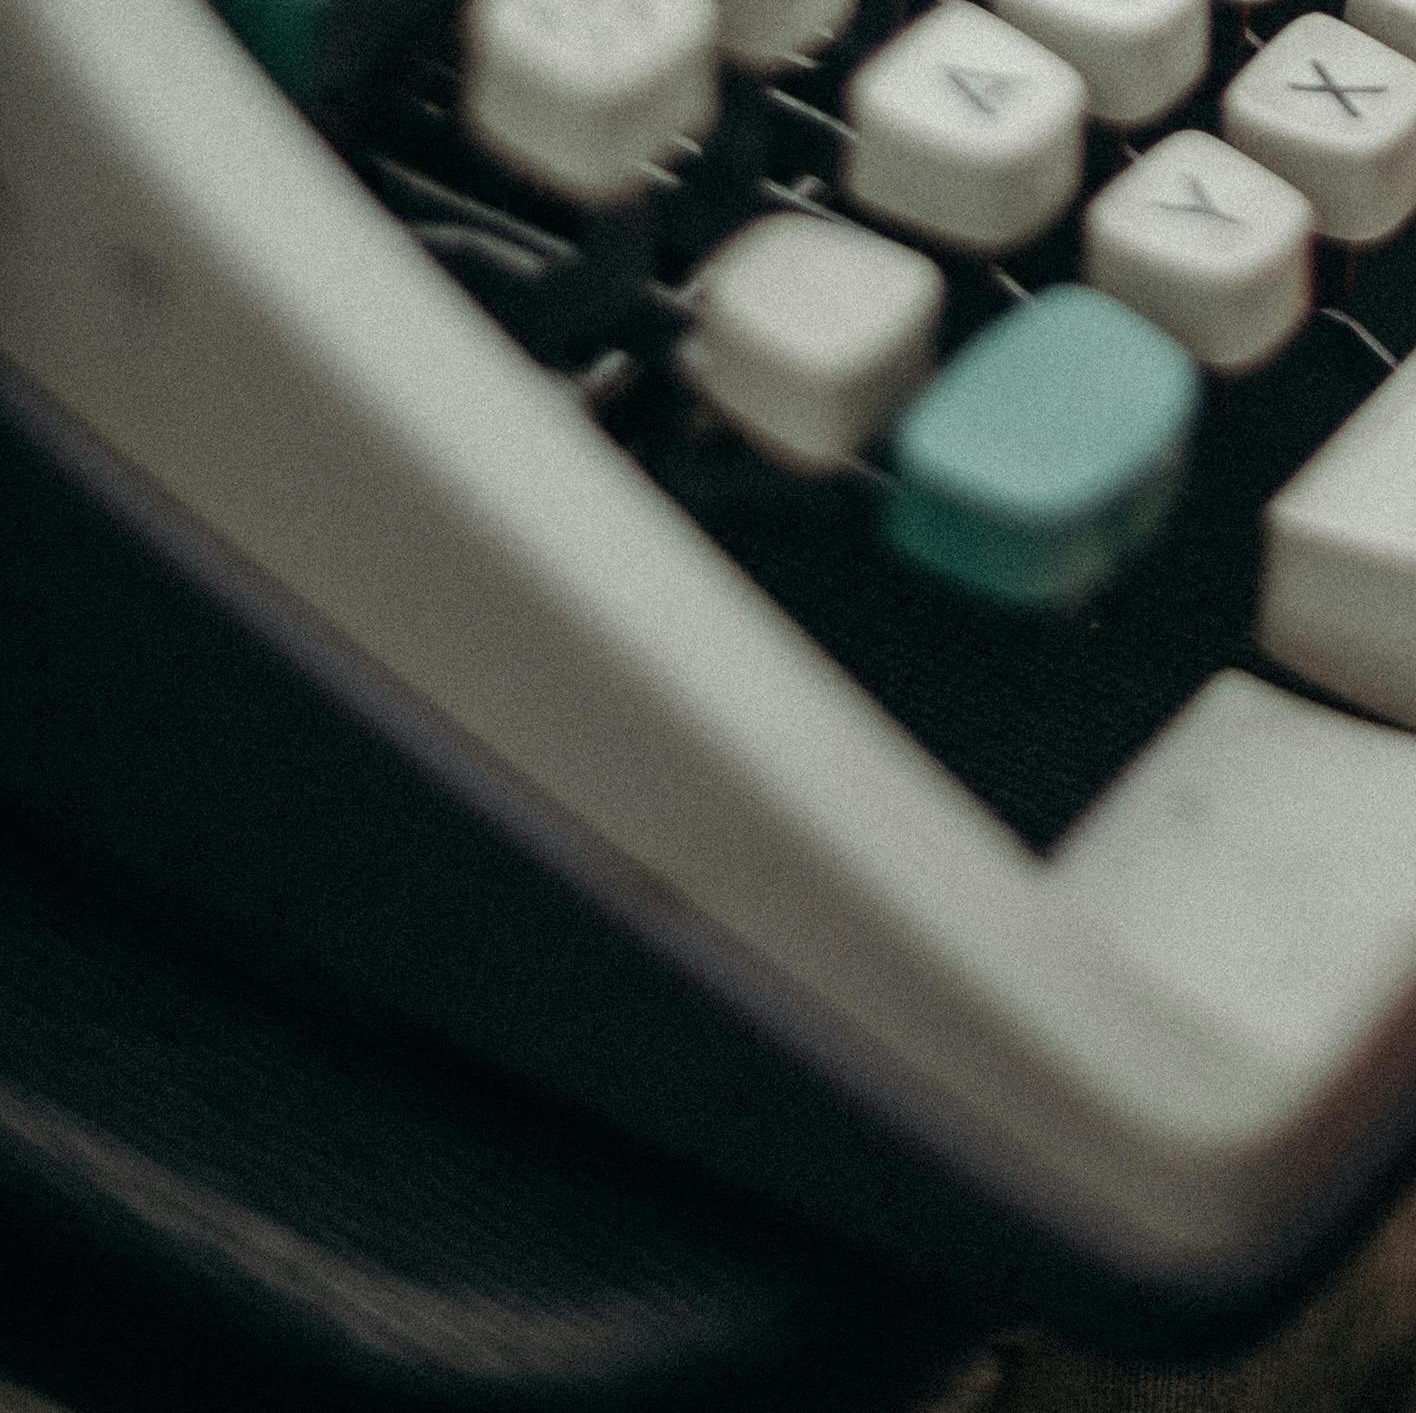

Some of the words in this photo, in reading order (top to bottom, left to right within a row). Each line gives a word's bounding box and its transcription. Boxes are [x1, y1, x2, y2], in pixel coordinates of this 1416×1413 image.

[942, 62, 1034, 117] A
[1286, 57, 1390, 120] X
[1148, 174, 1244, 229] Y
